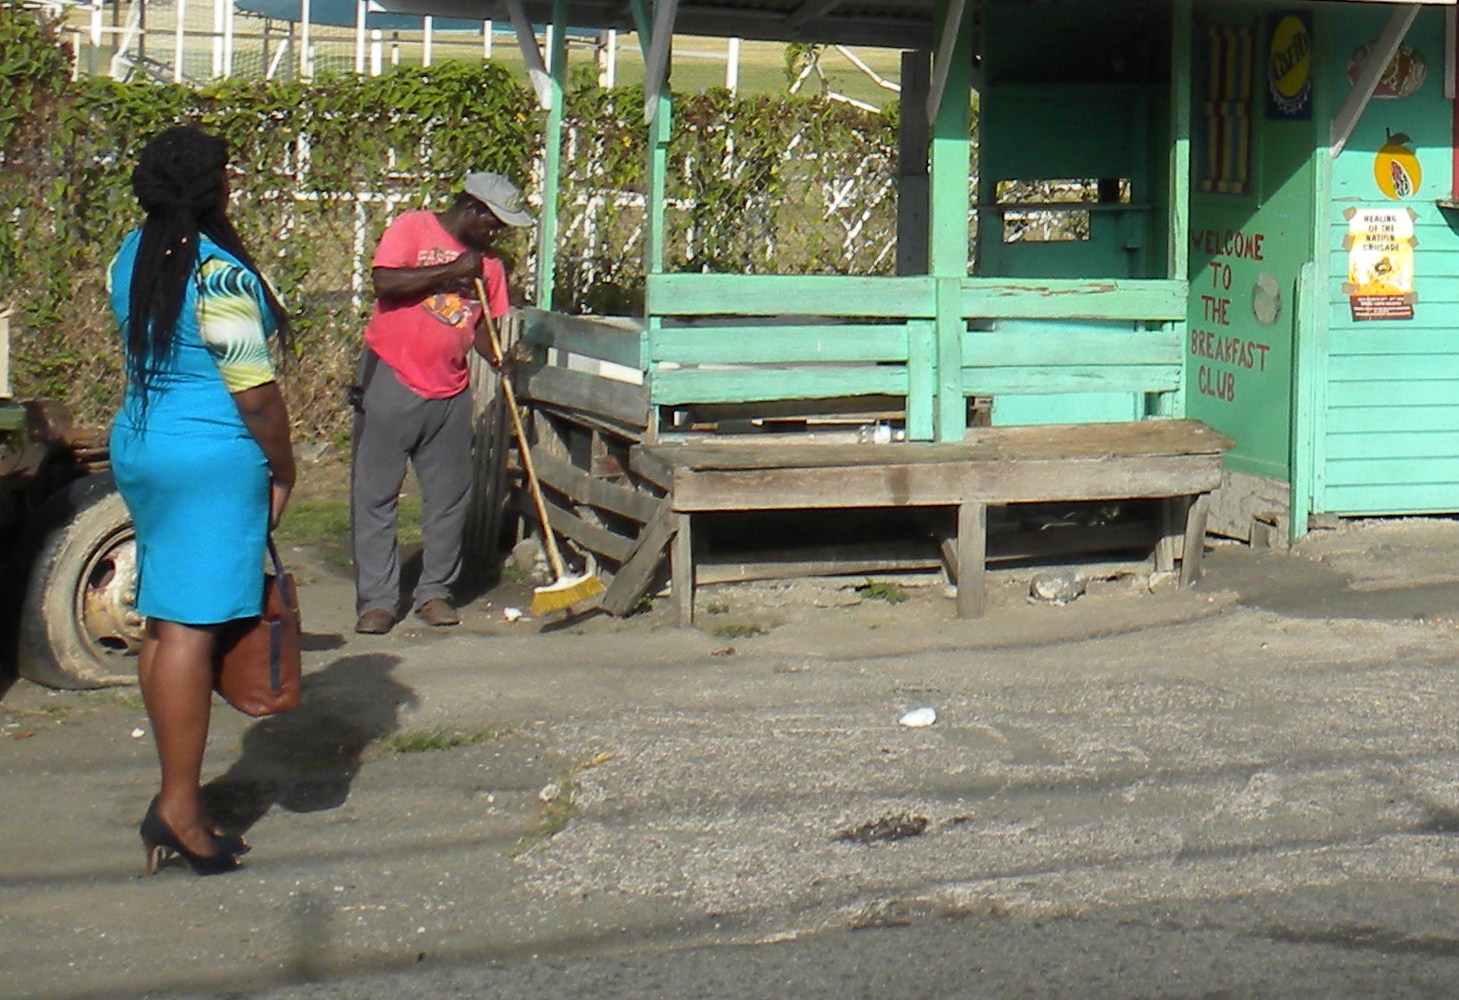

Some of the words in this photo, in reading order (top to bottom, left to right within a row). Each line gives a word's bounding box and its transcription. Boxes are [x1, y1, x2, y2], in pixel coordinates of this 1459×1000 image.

[1363, 215, 1397, 223] HEALING
[1368, 224, 1378, 232] OF
[1381, 224, 1394, 232] THE
[1190, 229, 1264, 260] WELCOME
[1363, 243, 1399, 251] CRUSADE
[1366, 234, 1395, 242] NATION
[1209, 261, 1232, 290] TO
[1201, 294, 1231, 326] THE
[1190, 328, 1270, 373] BREAKFAST
[1197, 365, 1235, 402] CLUB
